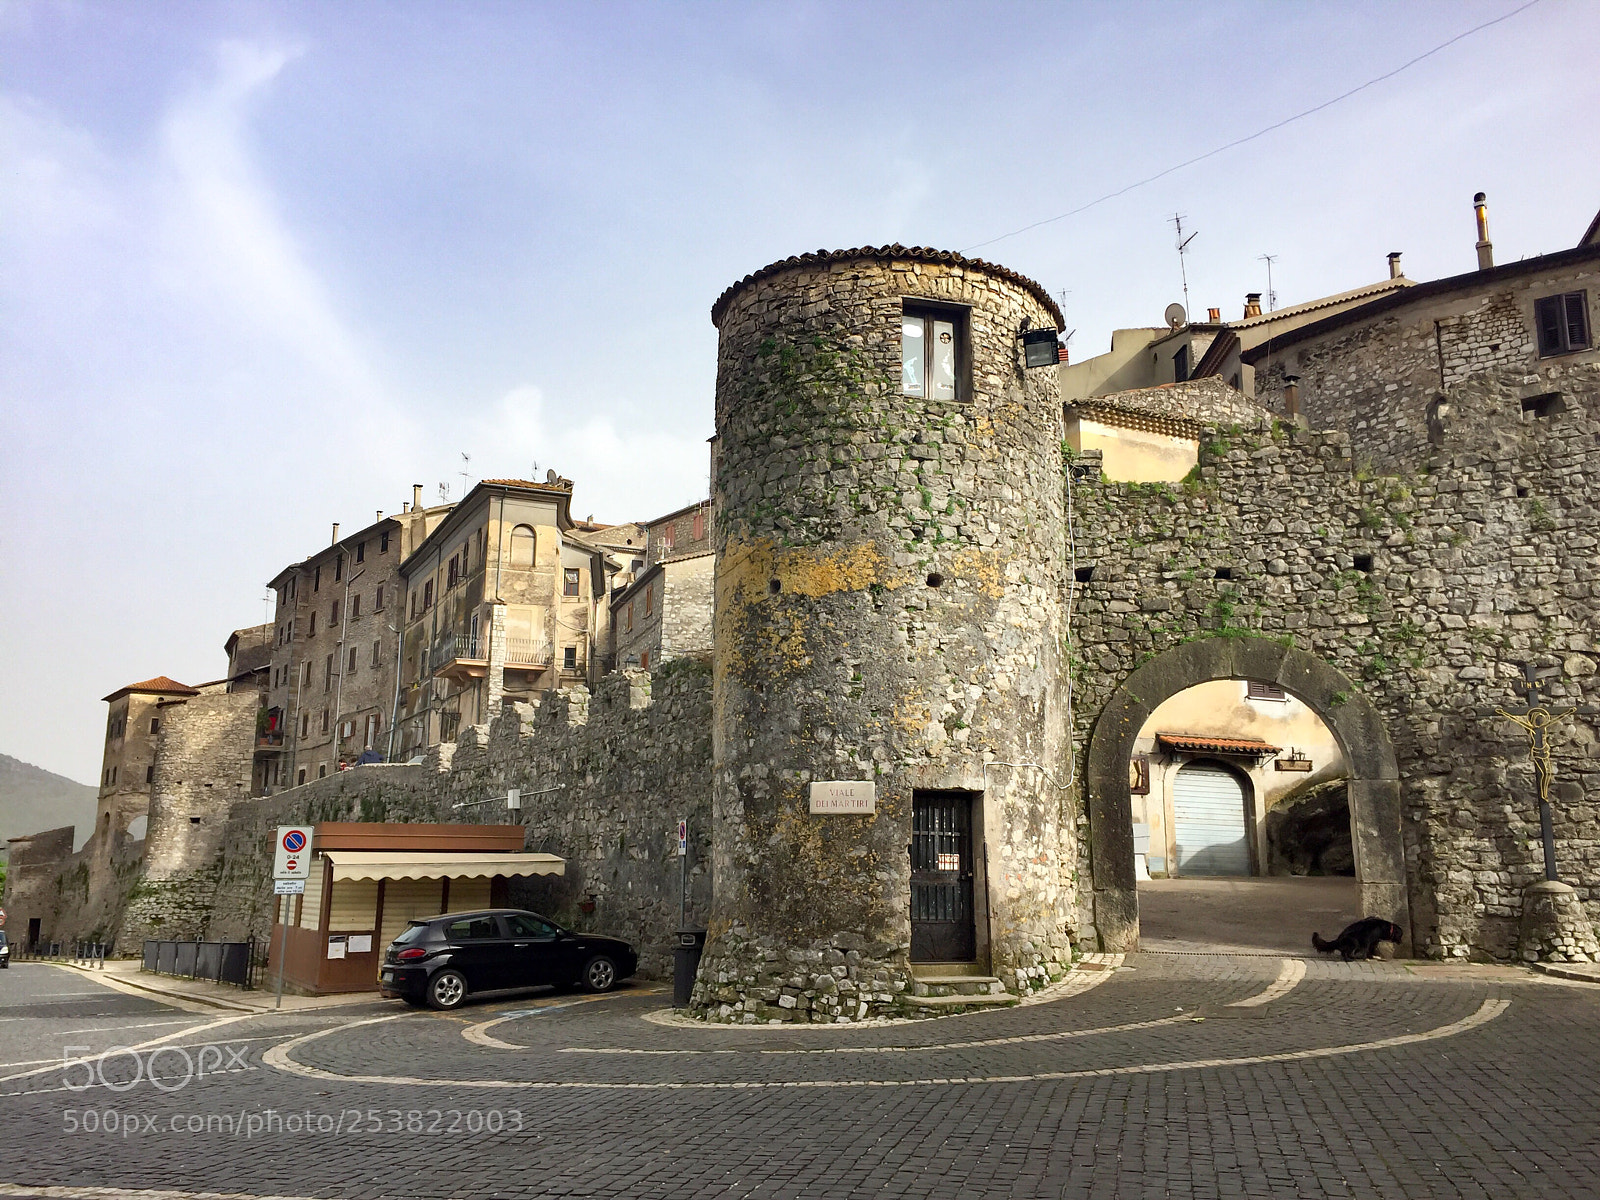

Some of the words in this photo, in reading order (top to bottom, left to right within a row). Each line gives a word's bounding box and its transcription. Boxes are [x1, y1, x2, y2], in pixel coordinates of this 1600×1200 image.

[829, 788, 855, 797] VIALE
[815, 799, 829, 808] DEI
[830, 799, 868, 808] MARTIRI
